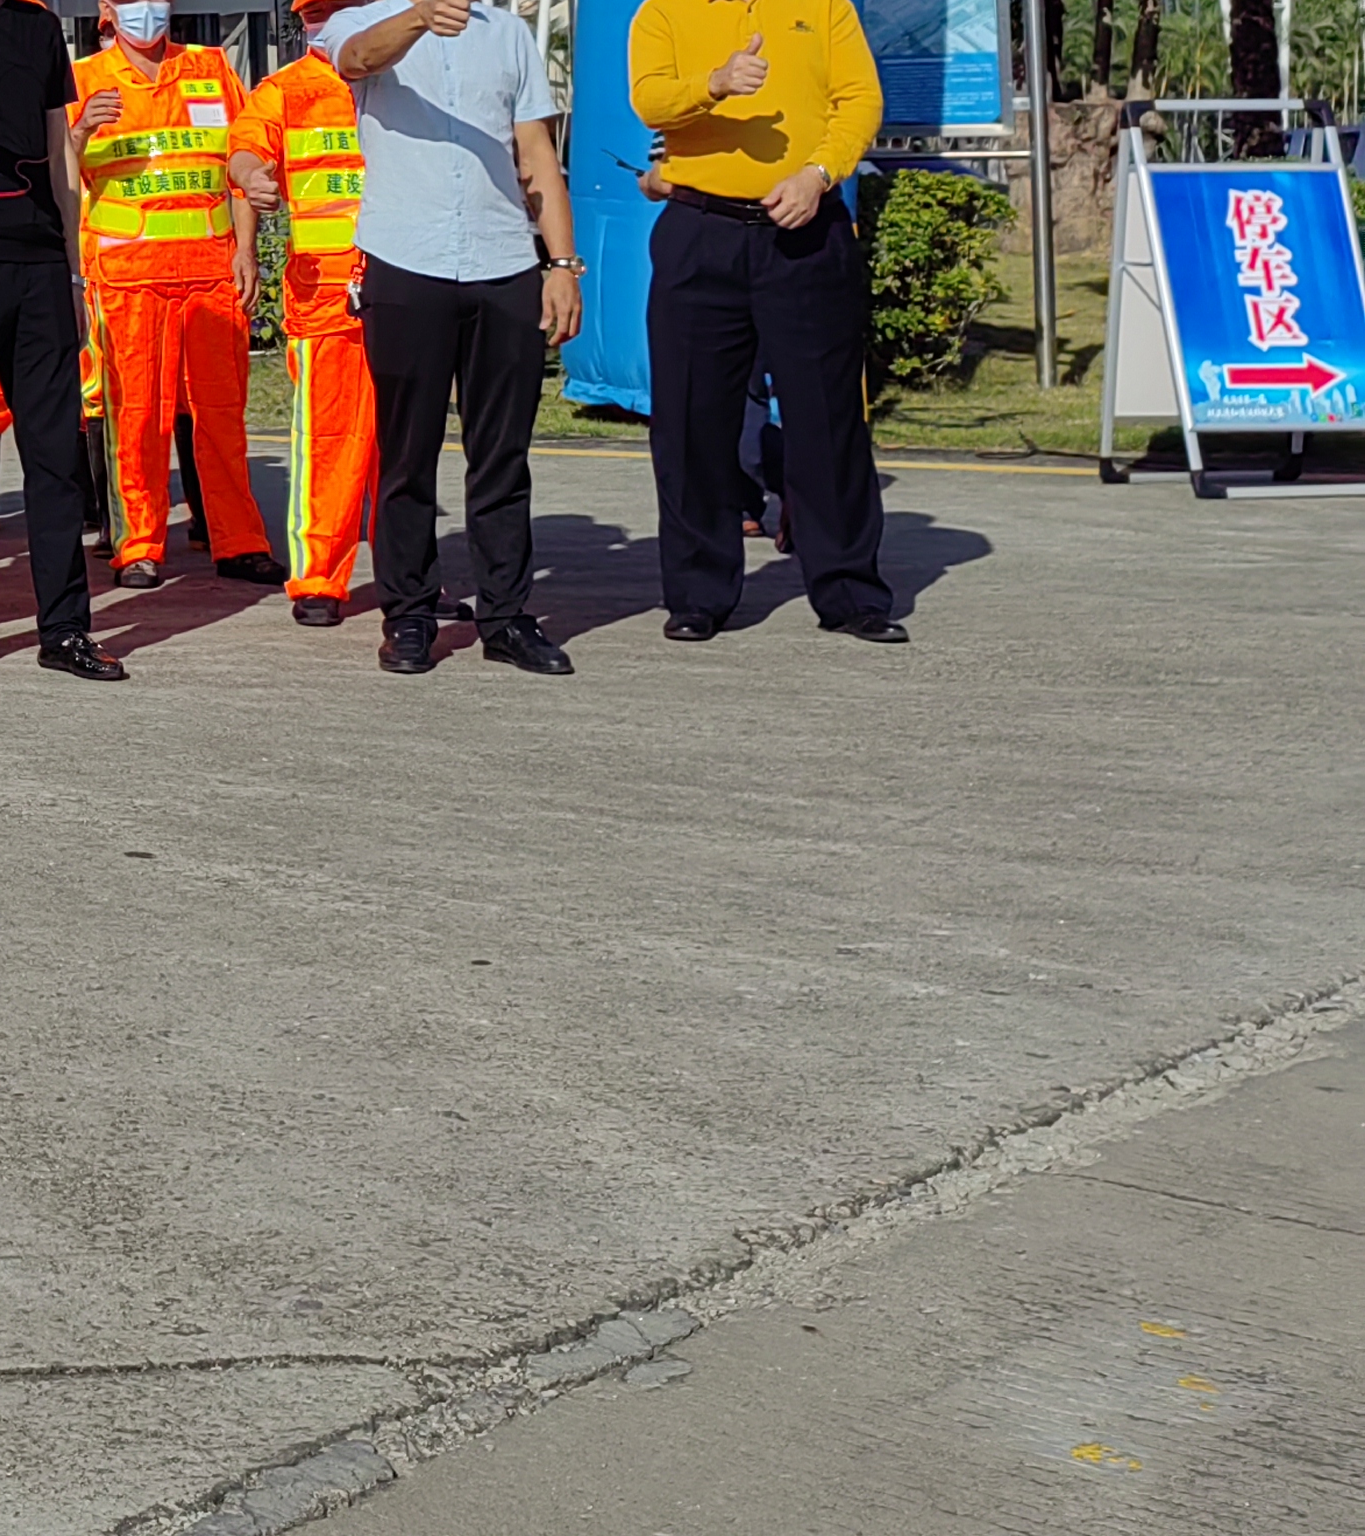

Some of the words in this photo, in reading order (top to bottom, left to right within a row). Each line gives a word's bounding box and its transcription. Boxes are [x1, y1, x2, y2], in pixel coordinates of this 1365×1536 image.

[122, 169, 211, 198] 建设美丽家园
[1226, 188, 1308, 352] 停车区
